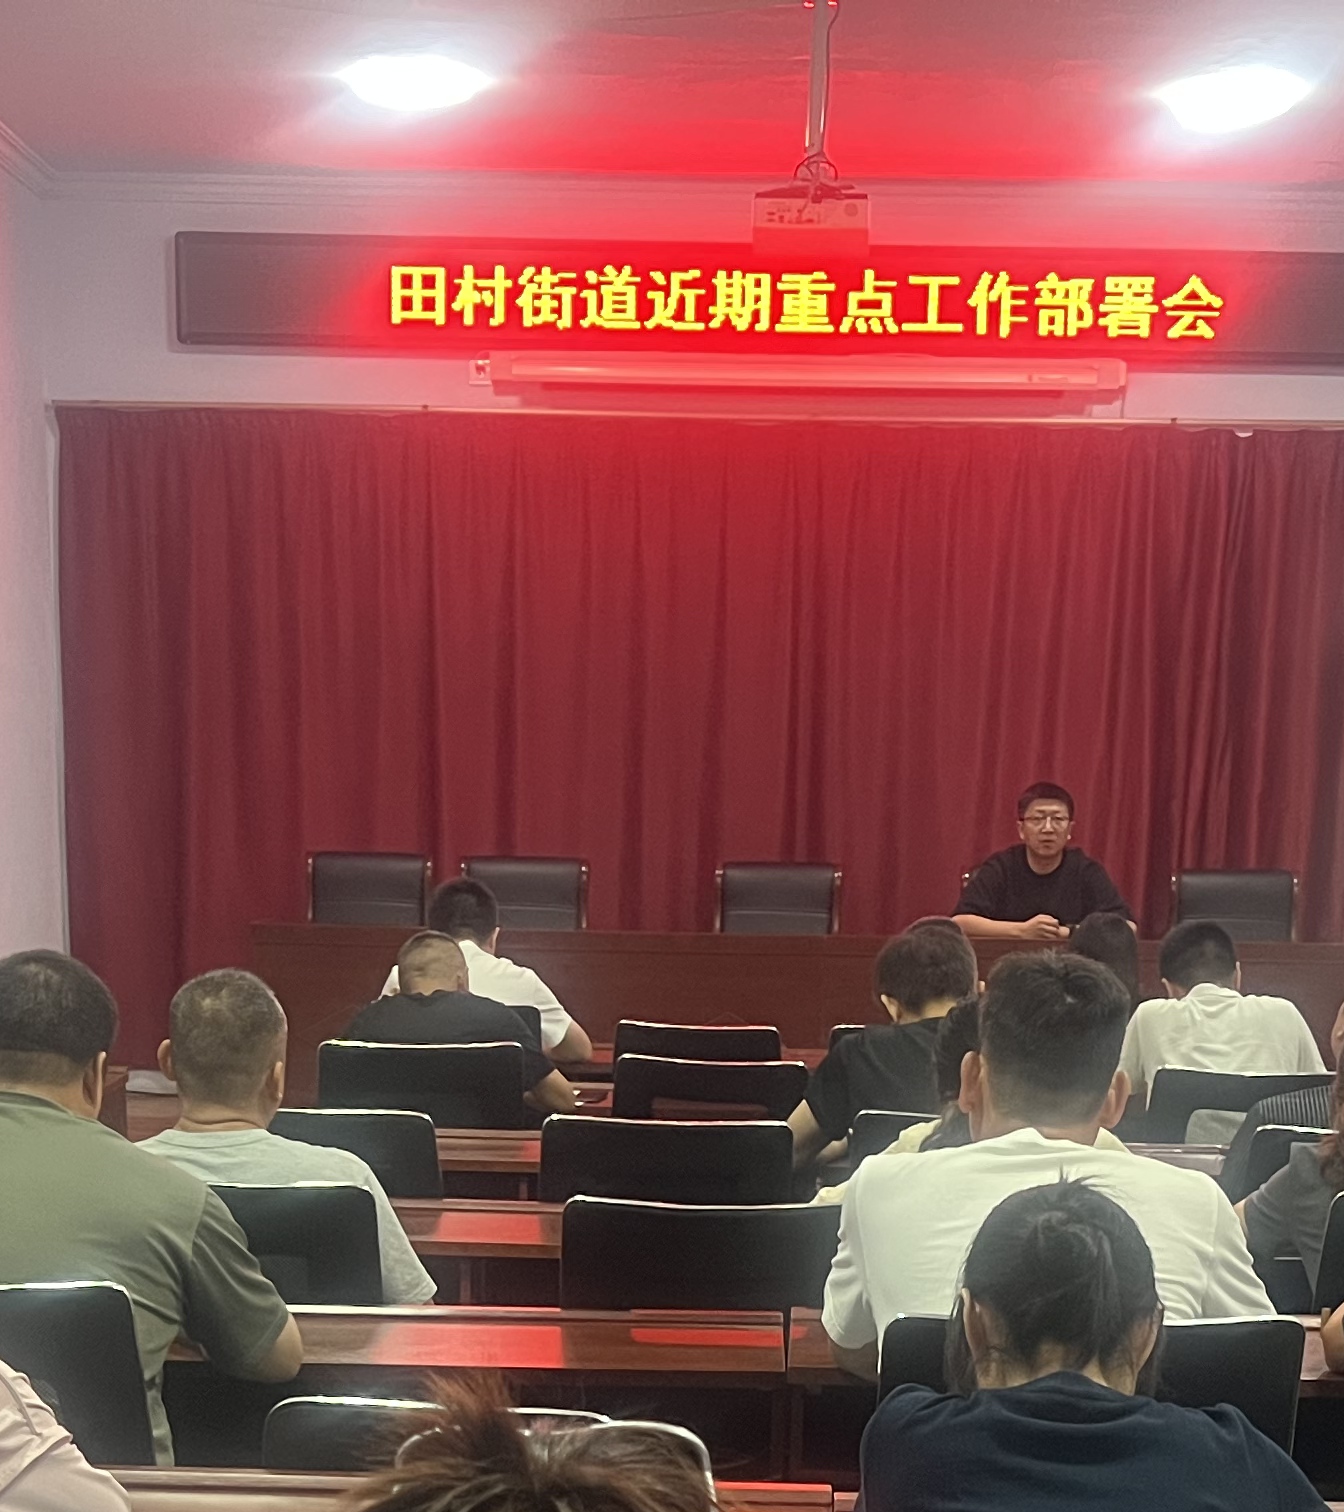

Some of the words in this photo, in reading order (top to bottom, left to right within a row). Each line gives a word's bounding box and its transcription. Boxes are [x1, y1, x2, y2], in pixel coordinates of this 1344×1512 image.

[390, 263, 1223, 339] 田村街道近期重点工作部署会
